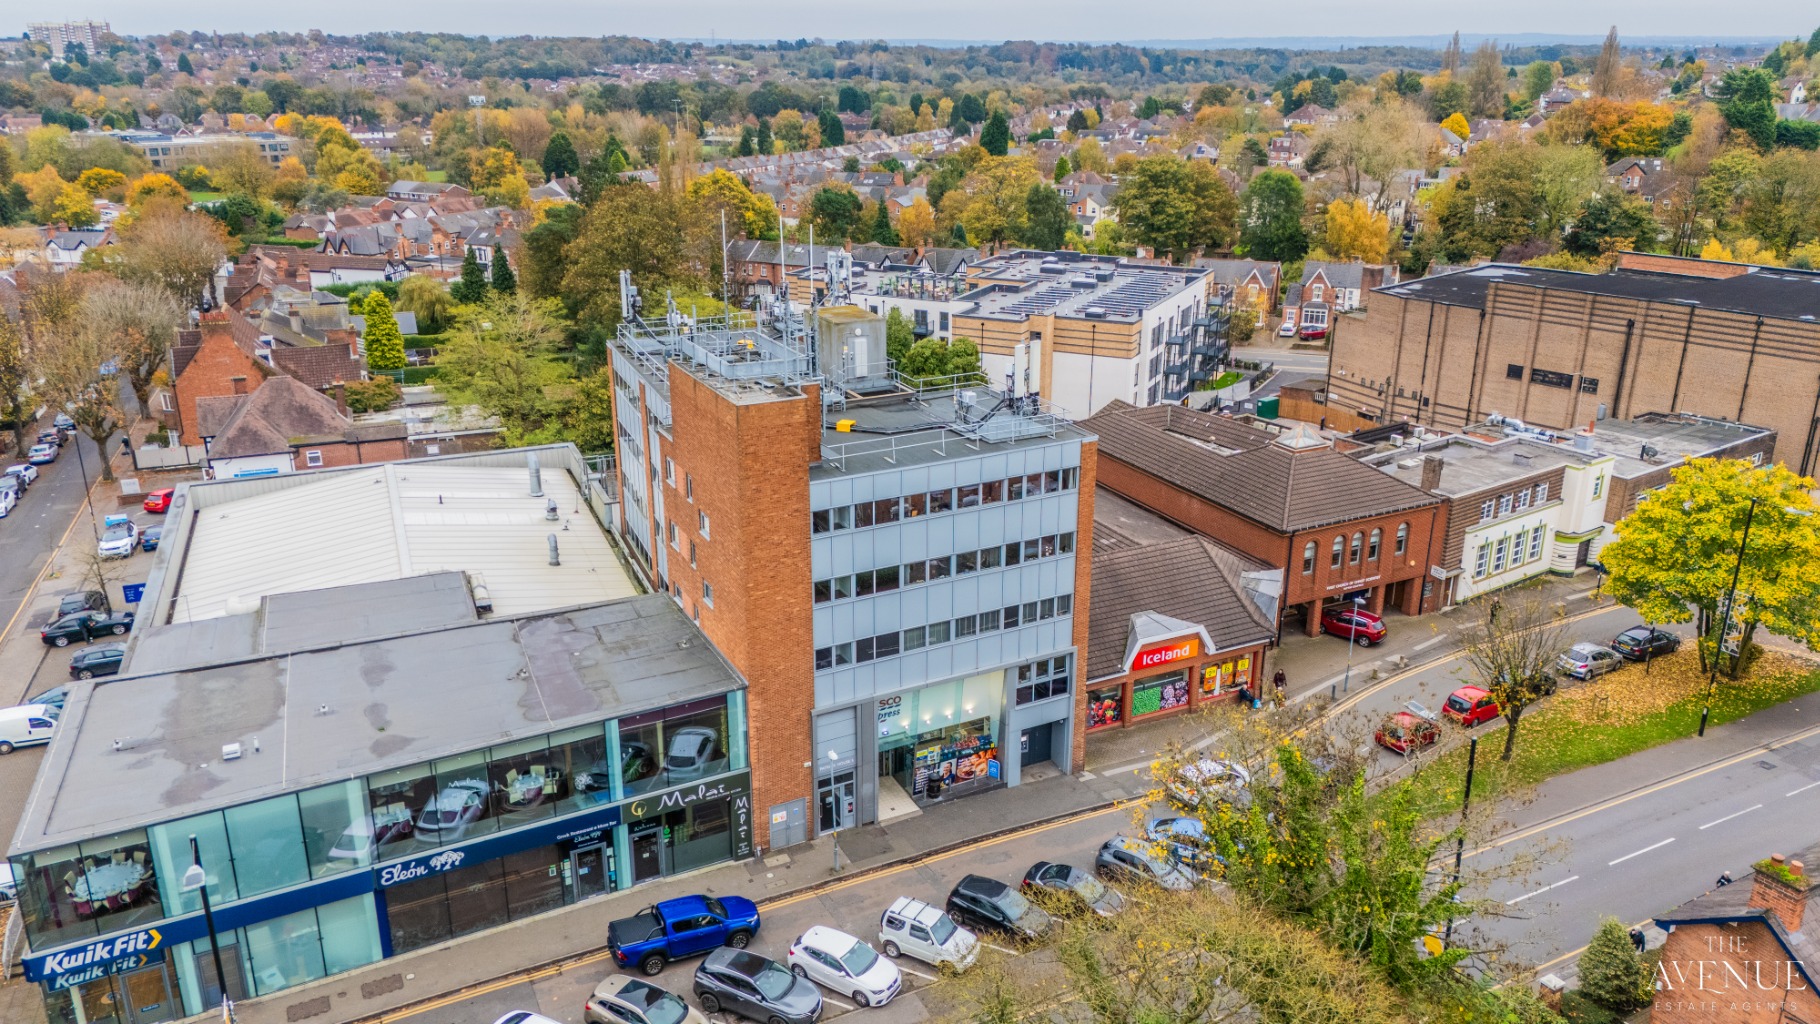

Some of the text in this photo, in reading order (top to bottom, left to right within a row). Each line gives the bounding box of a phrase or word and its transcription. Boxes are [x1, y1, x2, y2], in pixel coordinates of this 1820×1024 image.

[1142, 644, 1190, 666] Iceland
[380, 861, 429, 886] Eleón
[55, 955, 138, 989] Kwik Fit
